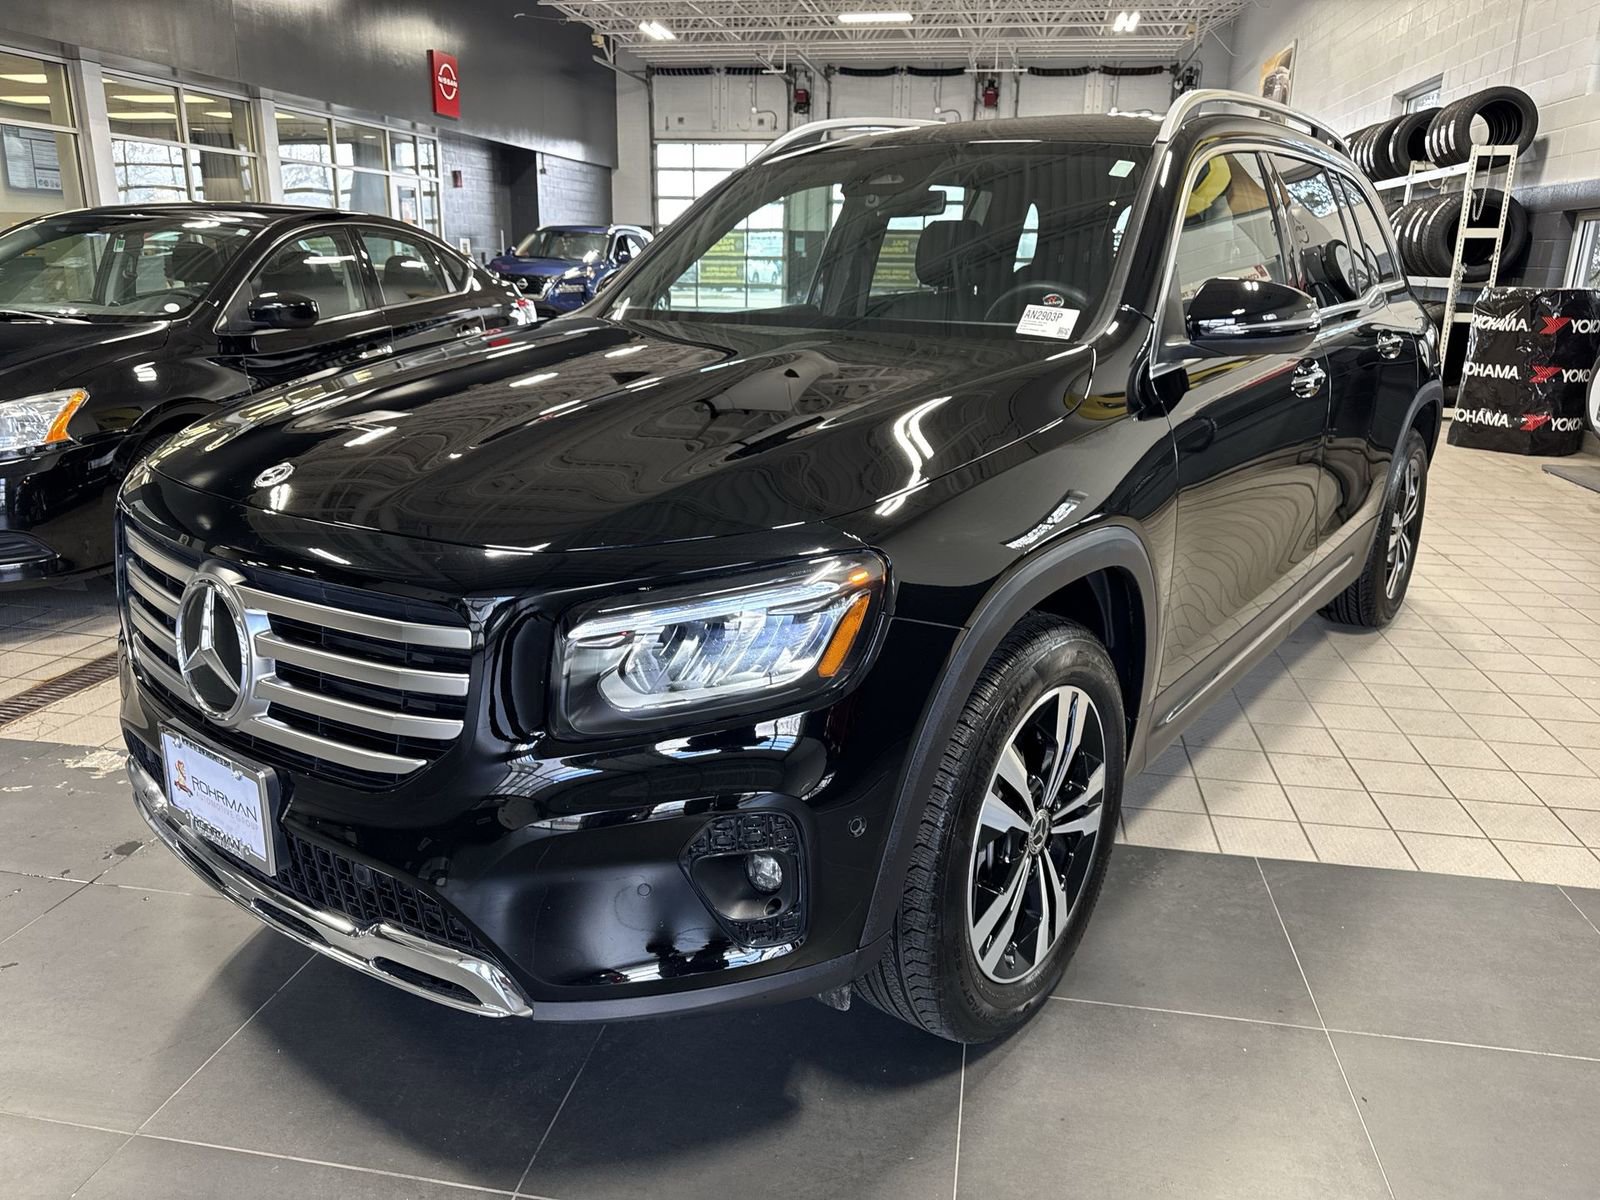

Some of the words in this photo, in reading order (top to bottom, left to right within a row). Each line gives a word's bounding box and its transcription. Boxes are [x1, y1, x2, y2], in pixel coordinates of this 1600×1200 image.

[1024, 309, 1064, 322] AN2903P
[1465, 361, 1519, 380] OHAMA
[1561, 368, 1591, 383] YOKO
[1551, 417, 1583, 431] YOKO
[191, 775, 258, 823] ROHRMAN
